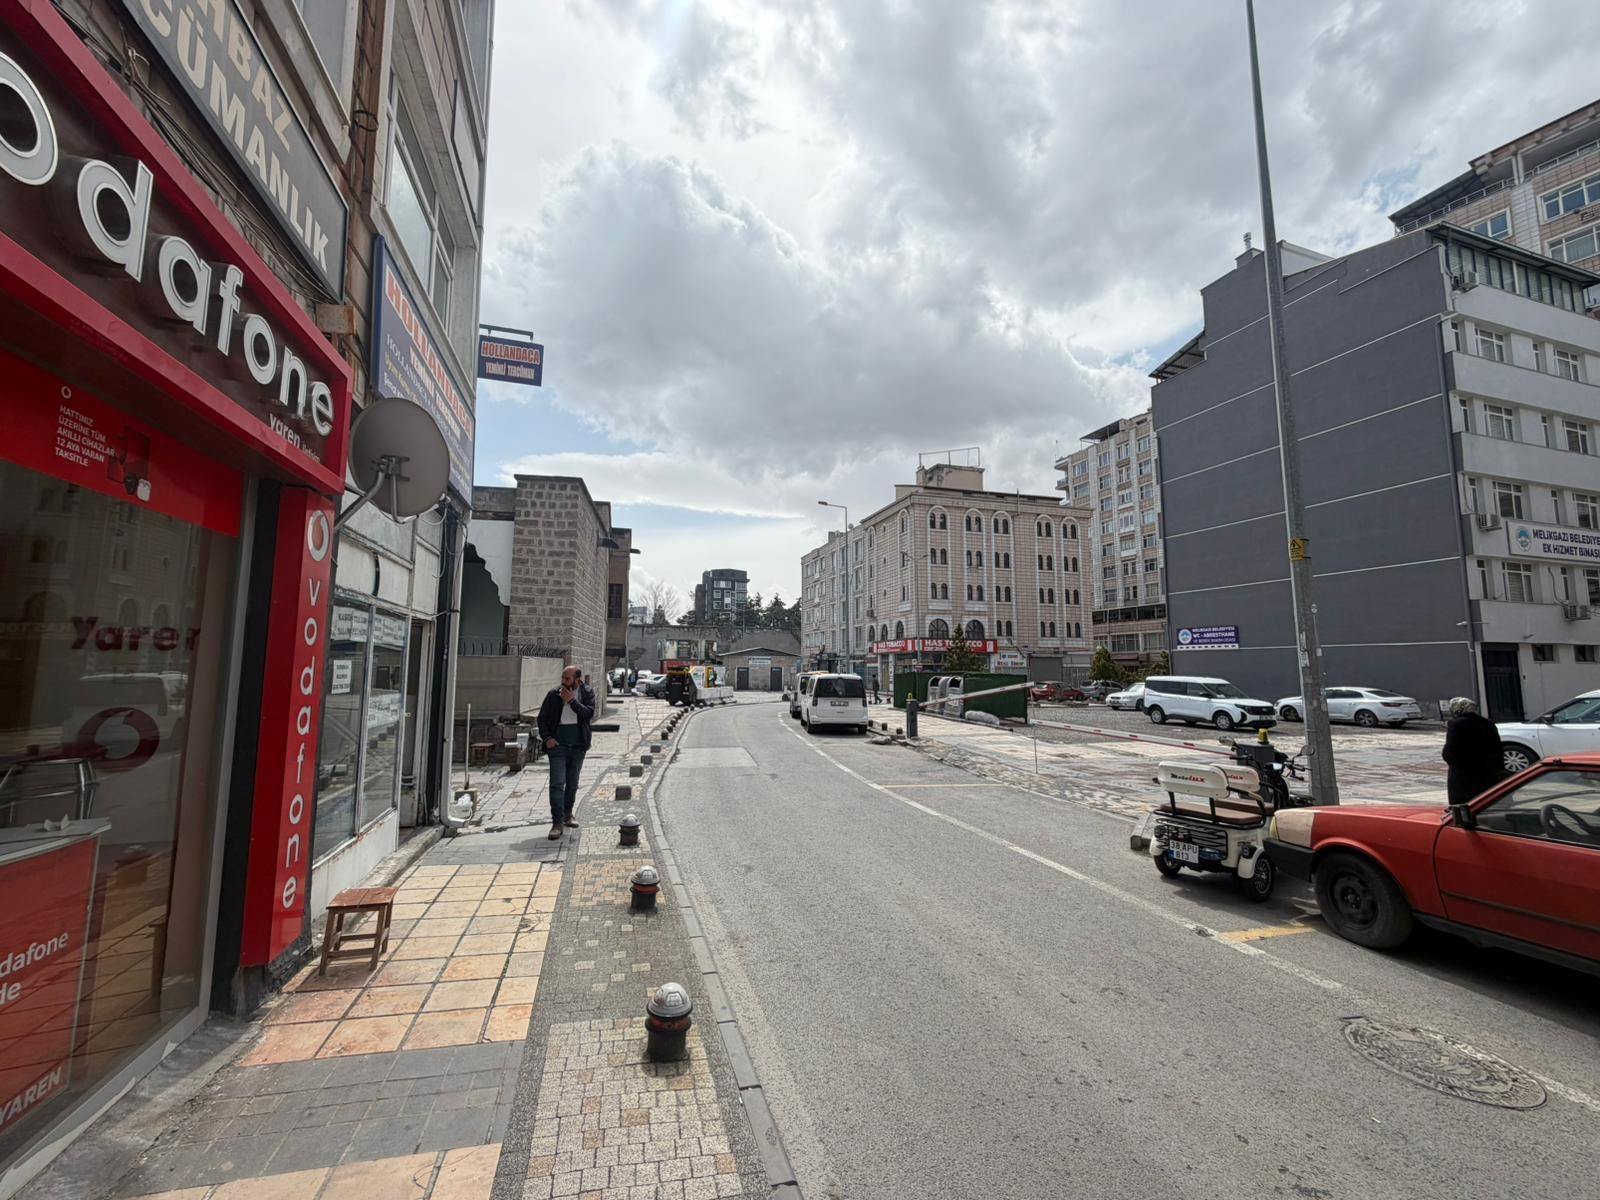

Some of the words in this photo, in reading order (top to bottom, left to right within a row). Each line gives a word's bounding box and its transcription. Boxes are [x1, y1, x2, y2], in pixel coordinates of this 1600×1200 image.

[386, 264, 472, 441] HOLLANDACA
[481, 341, 541, 365] HOLLANDACA
[60, 404, 94, 427] HATTINIZ
[57, 426, 80, 442] AKILLI
[58, 414, 91, 437] ÜZERİNE
[91, 429, 107, 443] TÜM
[55, 446, 89, 467] TAKSİTLE
[57, 437, 66, 447] 12
[66, 441, 80, 453] AYA
[81, 446, 105, 463] VARAN
[1533, 529, 1569, 542] MELİKGAZİ
[1543, 543, 1552, 554] EK
[1552, 544, 1578, 556] HİZMET
[925, 639, 941, 647] HAS
[282, 577, 322, 909] vodafone
[1182, 844, 1198, 854] APU
[0, 931, 69, 977] dafone
[0, 1066, 62, 1125] YAREN
